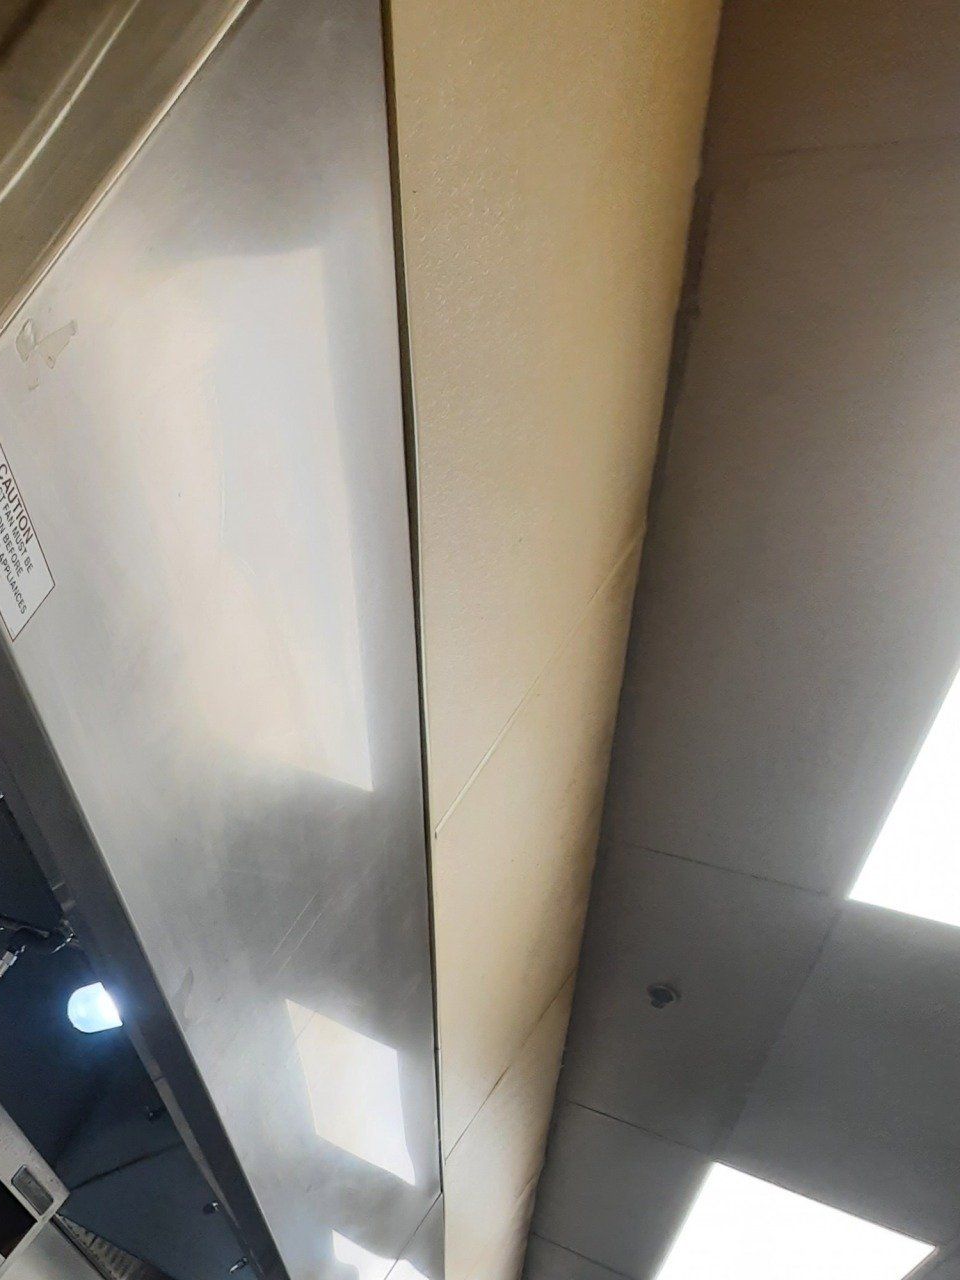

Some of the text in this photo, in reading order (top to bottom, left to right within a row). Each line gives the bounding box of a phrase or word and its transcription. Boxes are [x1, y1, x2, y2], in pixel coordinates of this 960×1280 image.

[2, 502, 14, 527] FAN
[11, 525, 27, 557] MUST
[24, 555, 33, 573] BE
[2, 532, 23, 577] BEFORE
